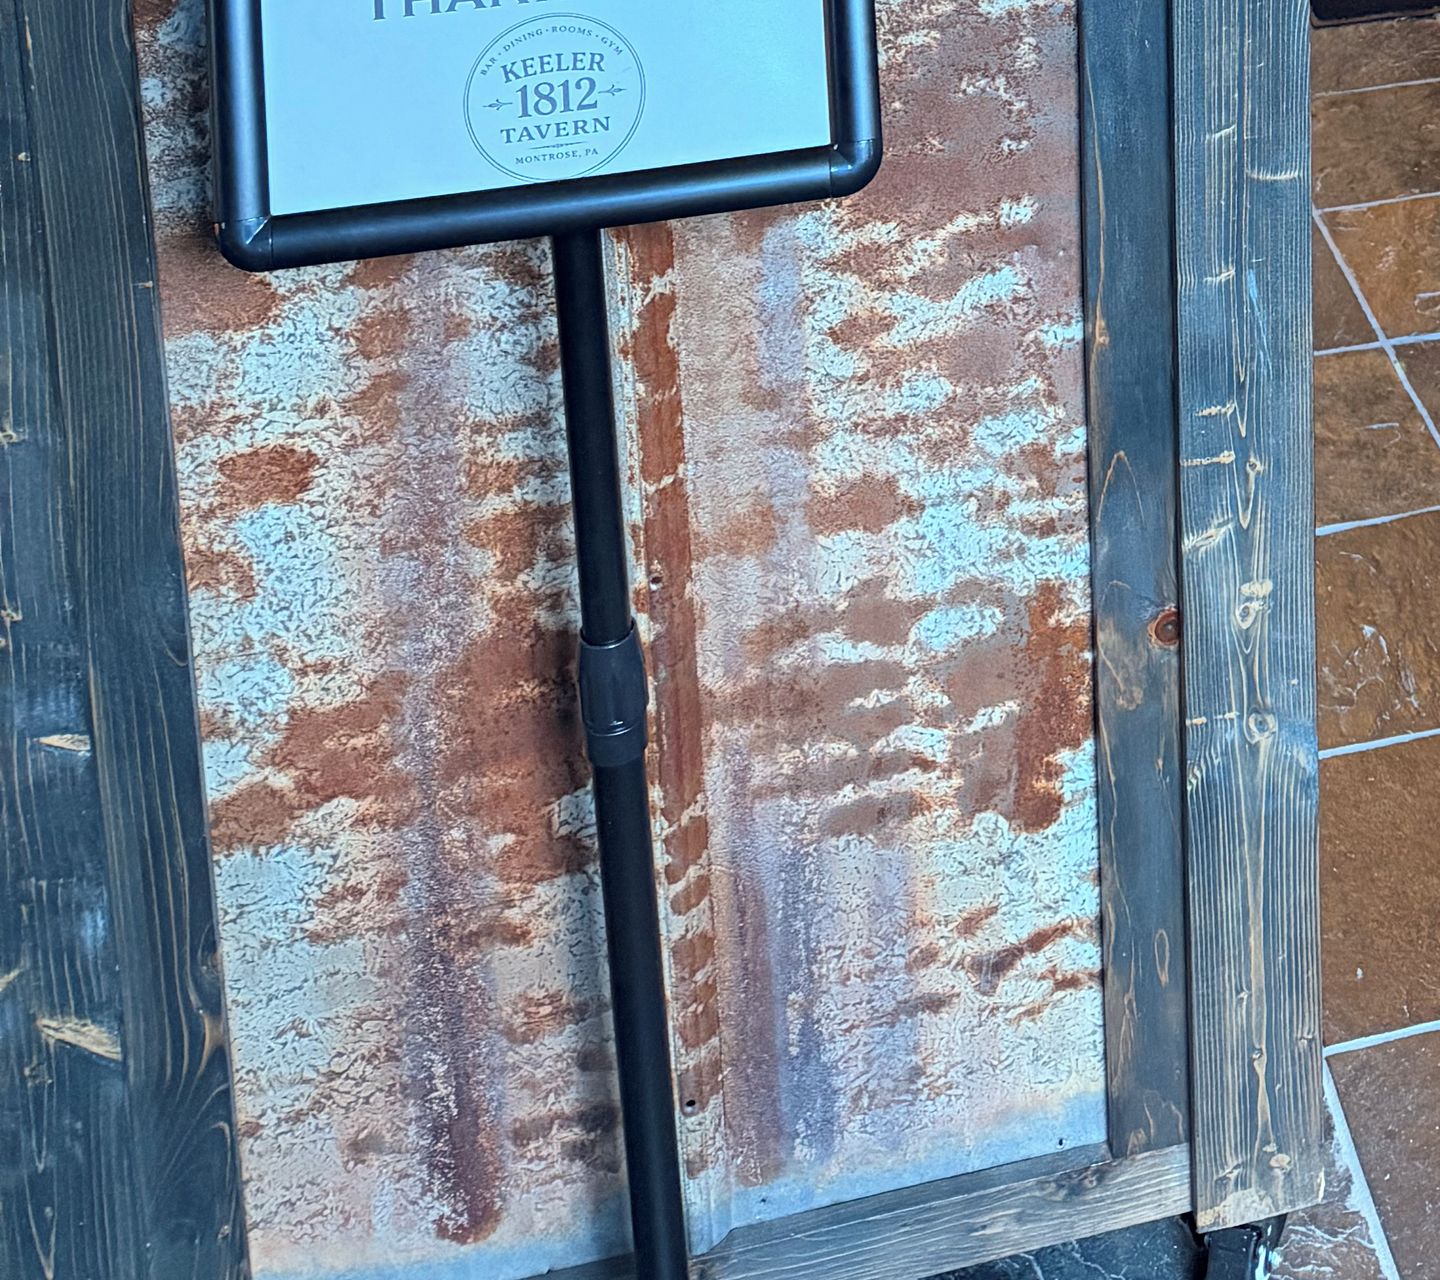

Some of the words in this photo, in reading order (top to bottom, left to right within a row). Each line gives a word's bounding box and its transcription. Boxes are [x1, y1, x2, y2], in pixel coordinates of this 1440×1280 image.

[480, 56, 498, 76] BAR
[503, 28, 543, 53] DINING
[551, 25, 593, 37] ROOMS
[600, 36, 624, 56] GYM
[500, 52, 606, 84] KEELER
[515, 76, 598, 119] 1812
[500, 116, 611, 144] TAVERN
[515, 150, 582, 165] MONTROSE,
[585, 148, 599, 157] PA
